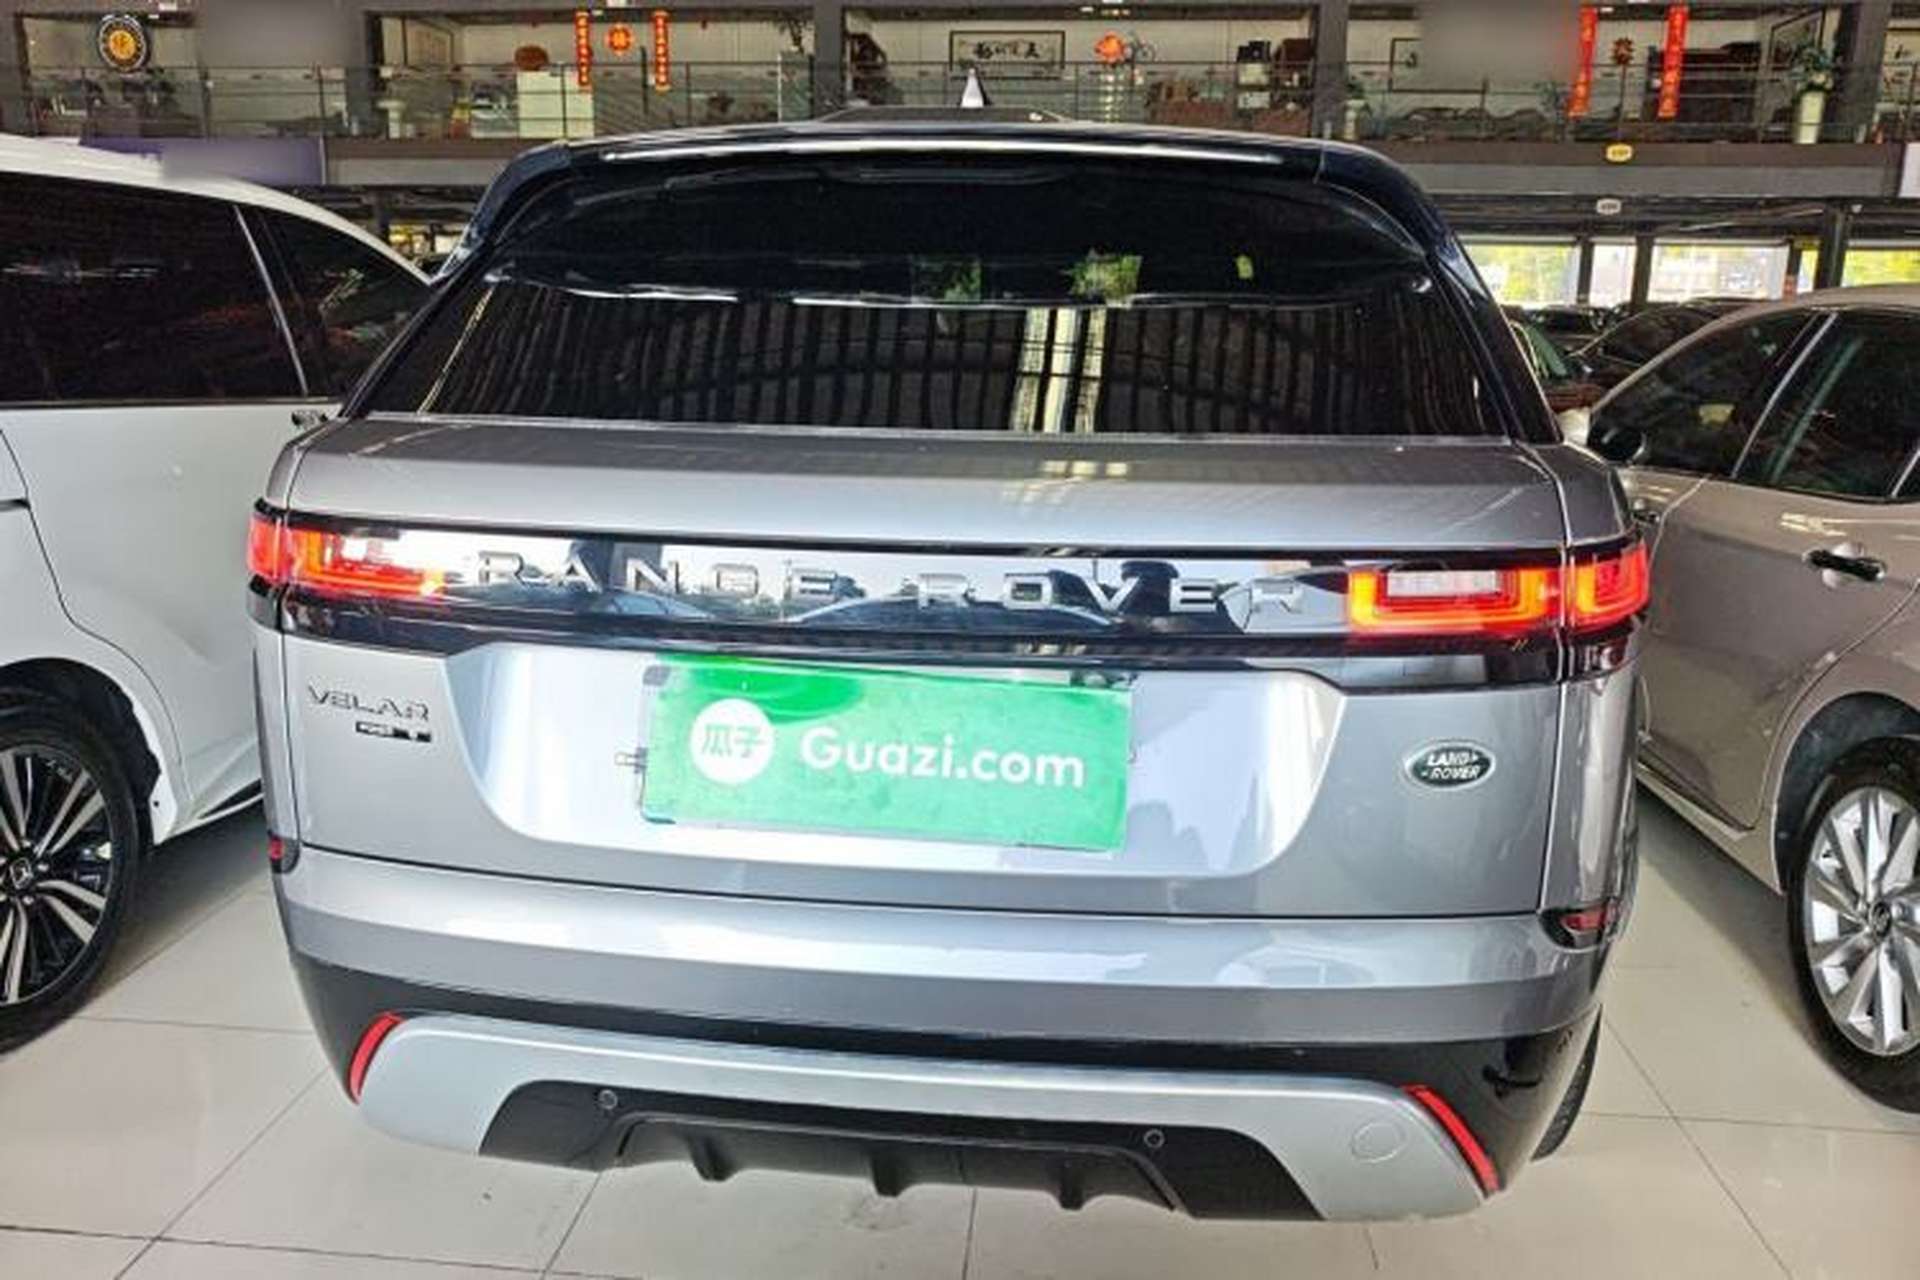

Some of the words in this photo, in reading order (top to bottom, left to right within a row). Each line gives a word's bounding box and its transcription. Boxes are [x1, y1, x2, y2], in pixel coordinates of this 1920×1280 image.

[478, 551, 840, 599] RANGE
[917, 572, 1306, 615] ROVER
[307, 684, 430, 721] VELAR
[701, 722, 766, 758] 瓜子
[800, 726, 1085, 788] Guazi.com
[1427, 751, 1471, 767] LAND
[1429, 766, 1480, 780] ROVER
